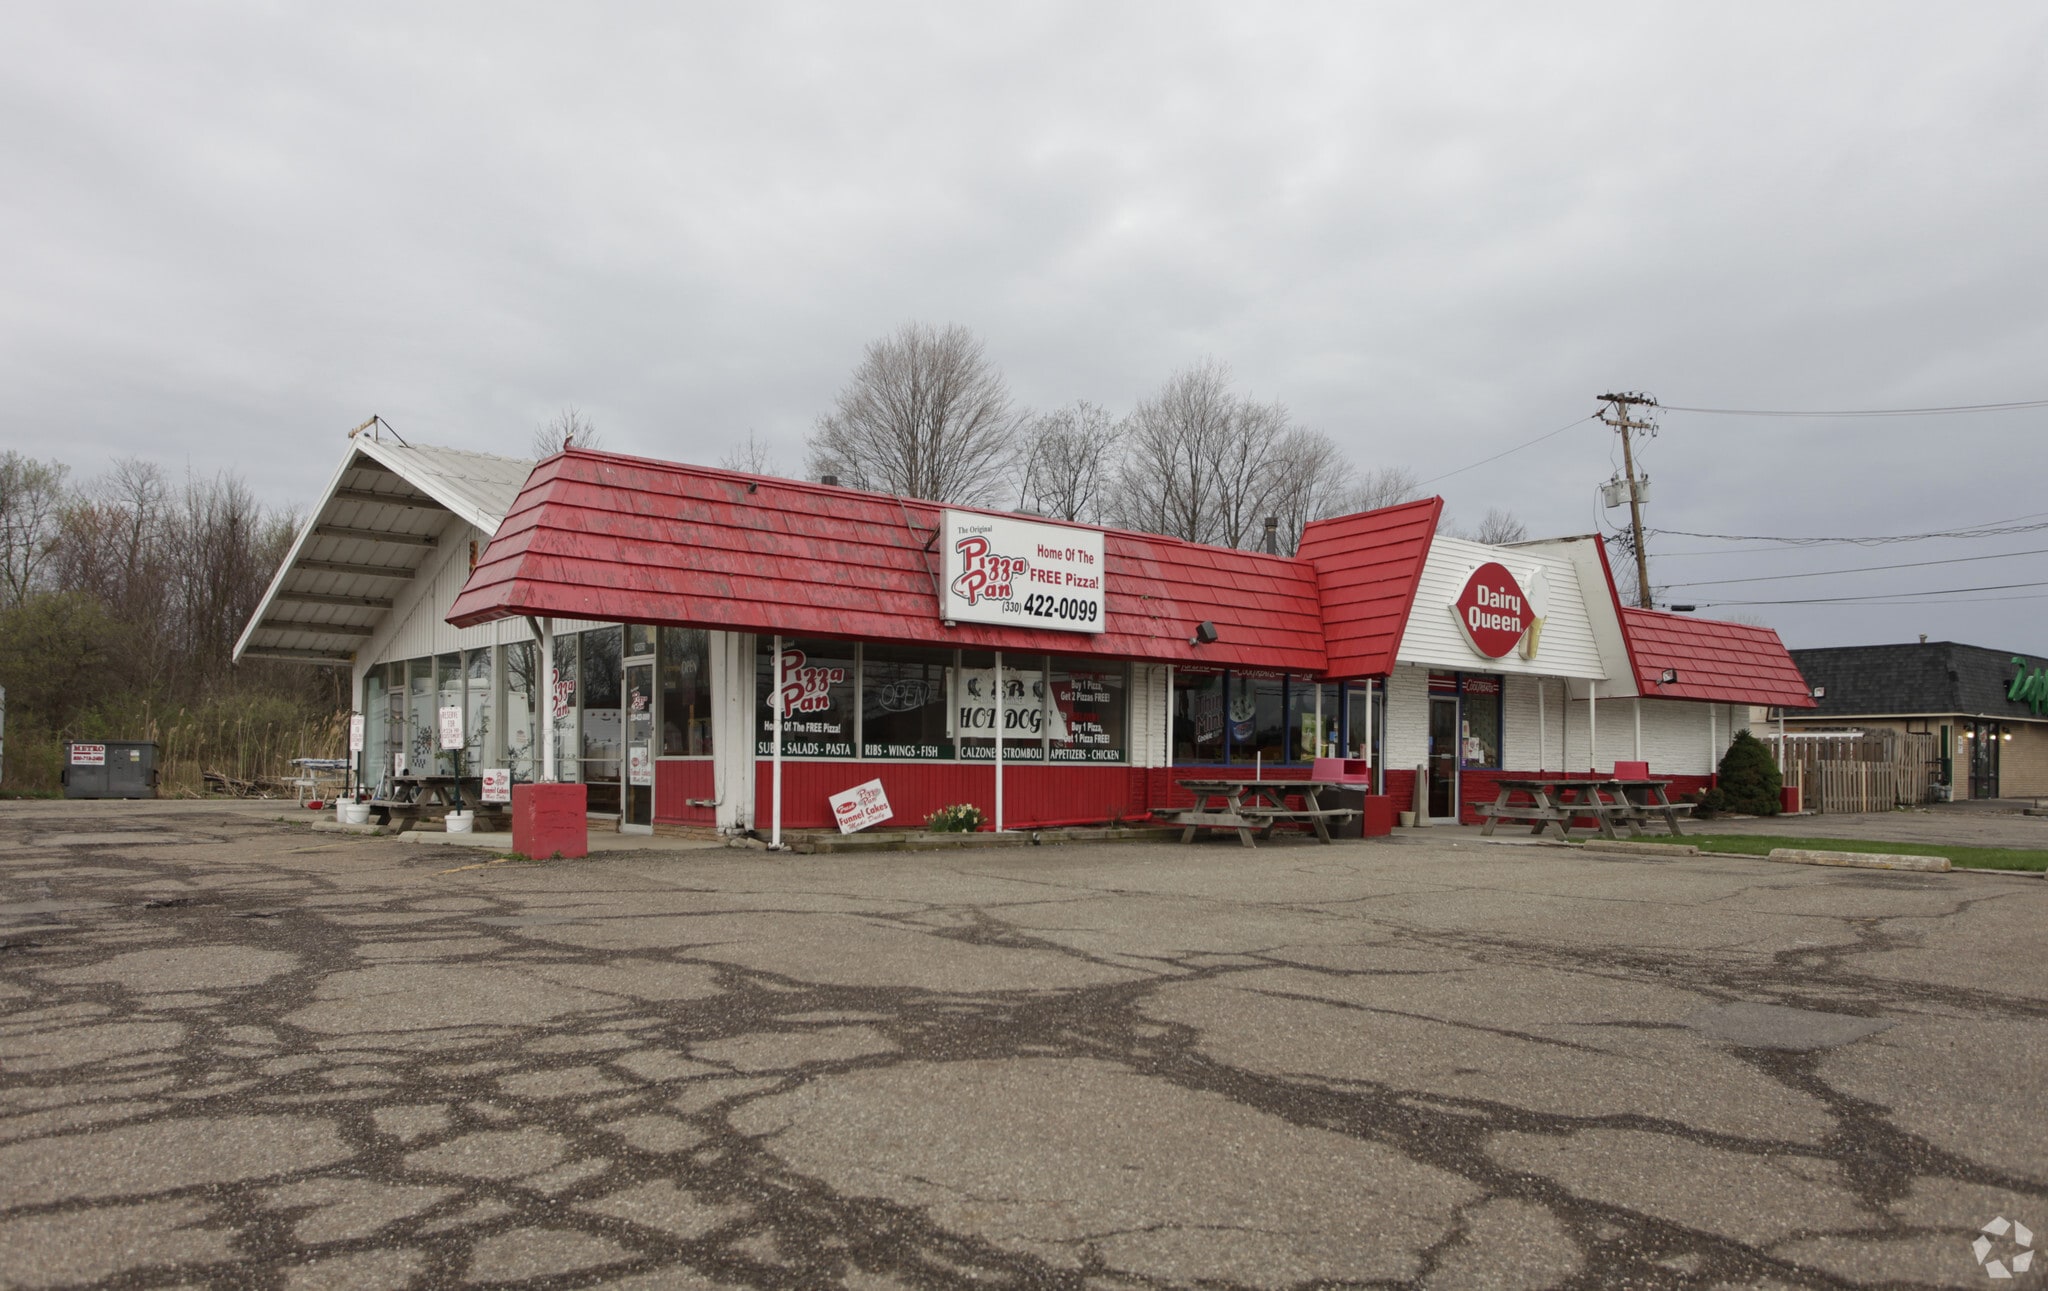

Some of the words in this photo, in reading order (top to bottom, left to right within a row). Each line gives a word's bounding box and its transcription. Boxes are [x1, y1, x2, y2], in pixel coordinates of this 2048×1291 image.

[969, 525, 993, 534] Original
[957, 536, 1026, 582] Pizza
[1037, 544, 1063, 561] Home
[1065, 548, 1075, 562] Of
[1078, 550, 1095, 565] The
[960, 569, 1012, 605] Pan
[1030, 568, 1062, 585] FREE
[1066, 573, 1100, 589] Pizza!
[1002, 601, 1022, 615] (330)
[1024, 593, 1098, 622] 422-0099
[1477, 584, 1521, 616] Dairy
[1468, 606, 1521, 632] Queen
[771, 650, 846, 693] Pizza
[1071, 680, 1082, 692] Buy
[1083, 680, 1086, 689] 1
[882, 684, 927, 706] OPEN
[1060, 692, 1071, 701] Get
[1072, 692, 1076, 701] 2
[1076, 692, 1094, 702] Pizzas
[784, 721, 792, 731] Of
[793, 721, 805, 732] The
[806, 722, 823, 733] FREE
[1071, 722, 1082, 734] Buy
[1083, 723, 1086, 732] 1
[1063, 734, 1074, 743] Get
[1075, 734, 1078, 743] 1
[1079, 734, 1093, 743] Pizza
[787, 742, 819, 755] SALADS
[825, 743, 851, 755] PASTA
[865, 744, 882, 756] RIBS
[888, 744, 915, 757] WINGS
[921, 745, 938, 757] FISH
[1003, 747, 1042, 759] STROMBOLI
[1050, 749, 1086, 759] APPETIZERS
[1091, 750, 1120, 760] CHICKEN
[839, 809, 865, 826] Funnel
[865, 803, 888, 815] Cakes
